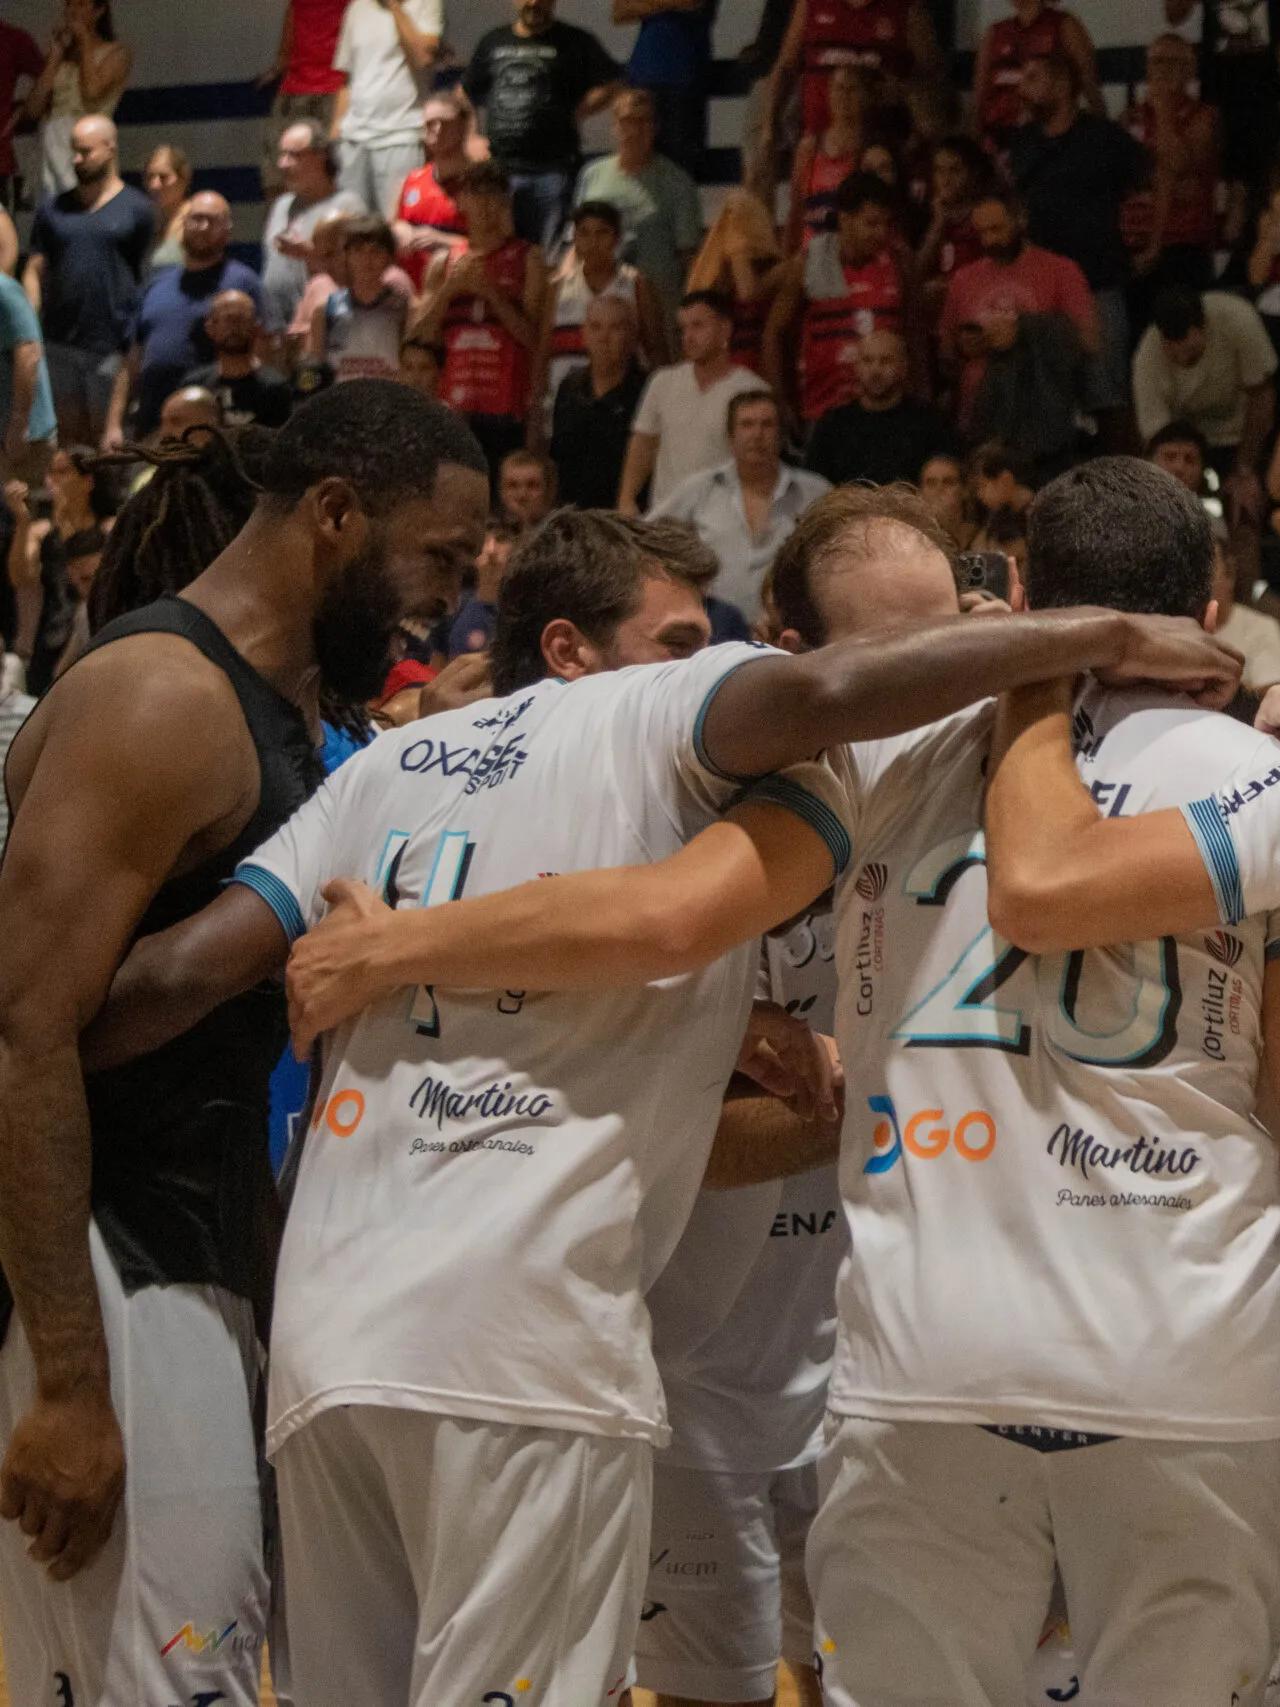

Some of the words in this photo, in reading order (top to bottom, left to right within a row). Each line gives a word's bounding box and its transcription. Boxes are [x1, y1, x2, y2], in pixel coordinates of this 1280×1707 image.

[856, 911, 874, 1016] Cortiluz
[408, 1076, 553, 1131] Martino
[1047, 1123, 1201, 1180] Martino
[1056, 1188, 1106, 1207] Panes
[1109, 1192, 1193, 1210] artesanales
